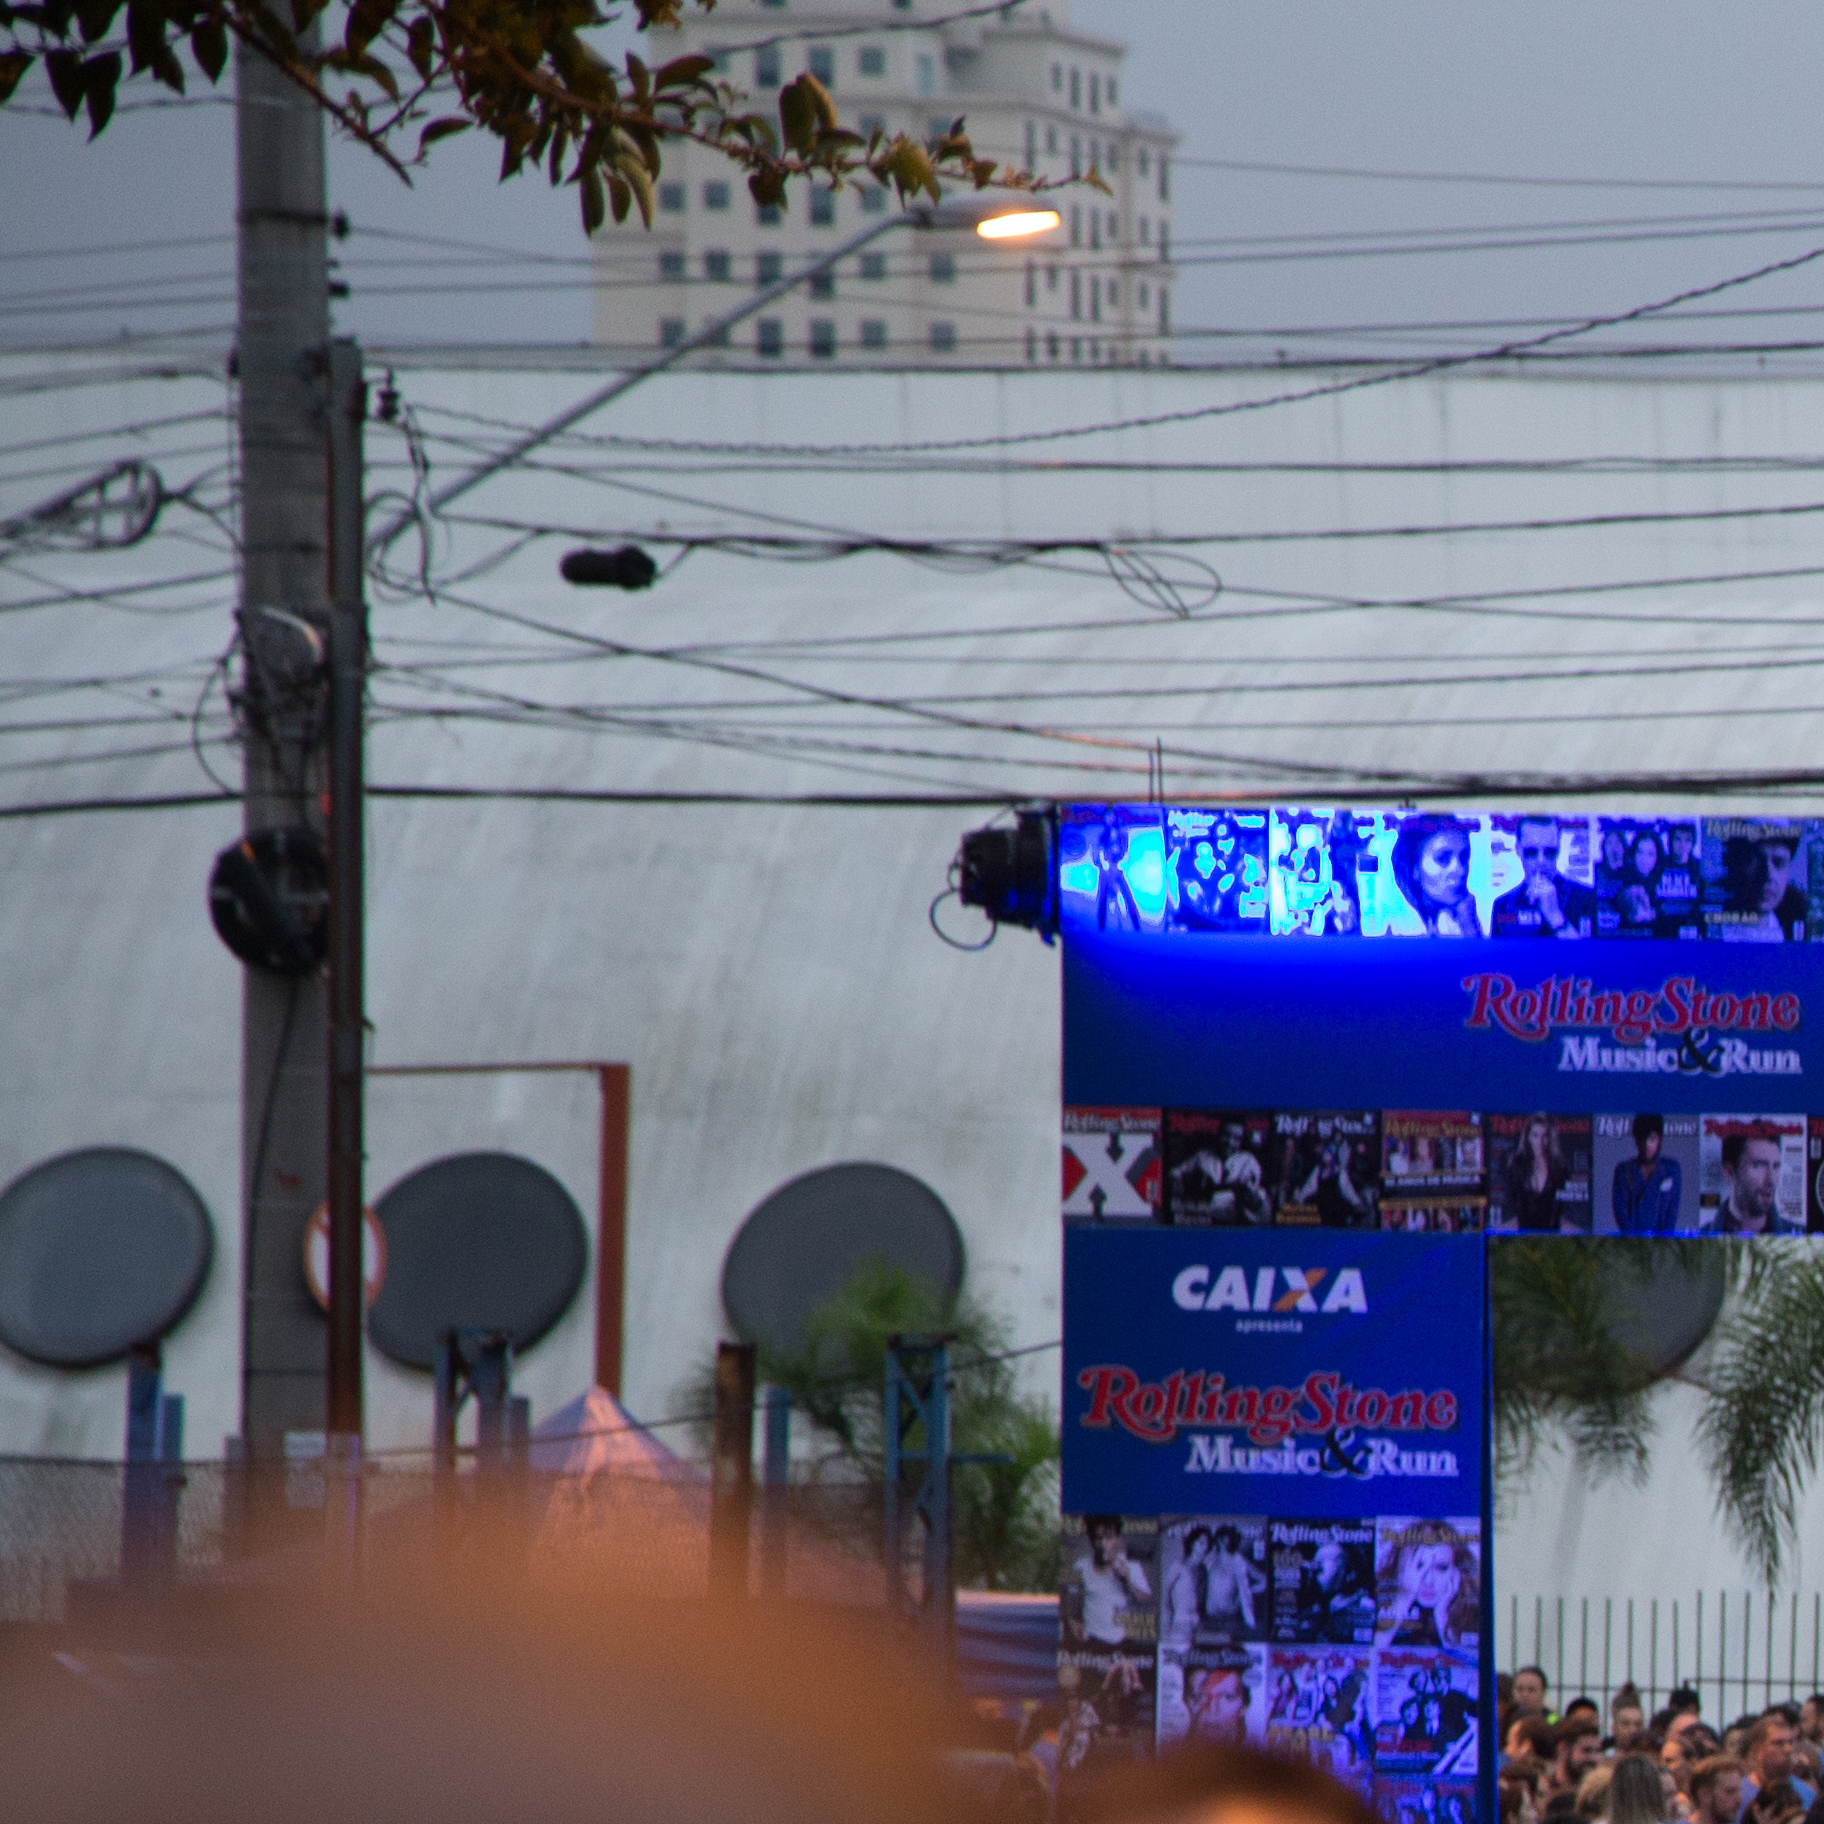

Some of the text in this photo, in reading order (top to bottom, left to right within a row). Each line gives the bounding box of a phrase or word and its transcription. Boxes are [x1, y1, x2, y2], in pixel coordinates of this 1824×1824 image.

[1462, 971, 1802, 1043] Rolling Stone
[1559, 1028, 1802, 1076] Music & Run
[1172, 1265, 1368, 1313] CAIXA
[1236, 1320, 1302, 1333] apresenta
[1079, 1364, 1459, 1443] Rolling Stone
[1184, 1428, 1460, 1478] Music & Run
